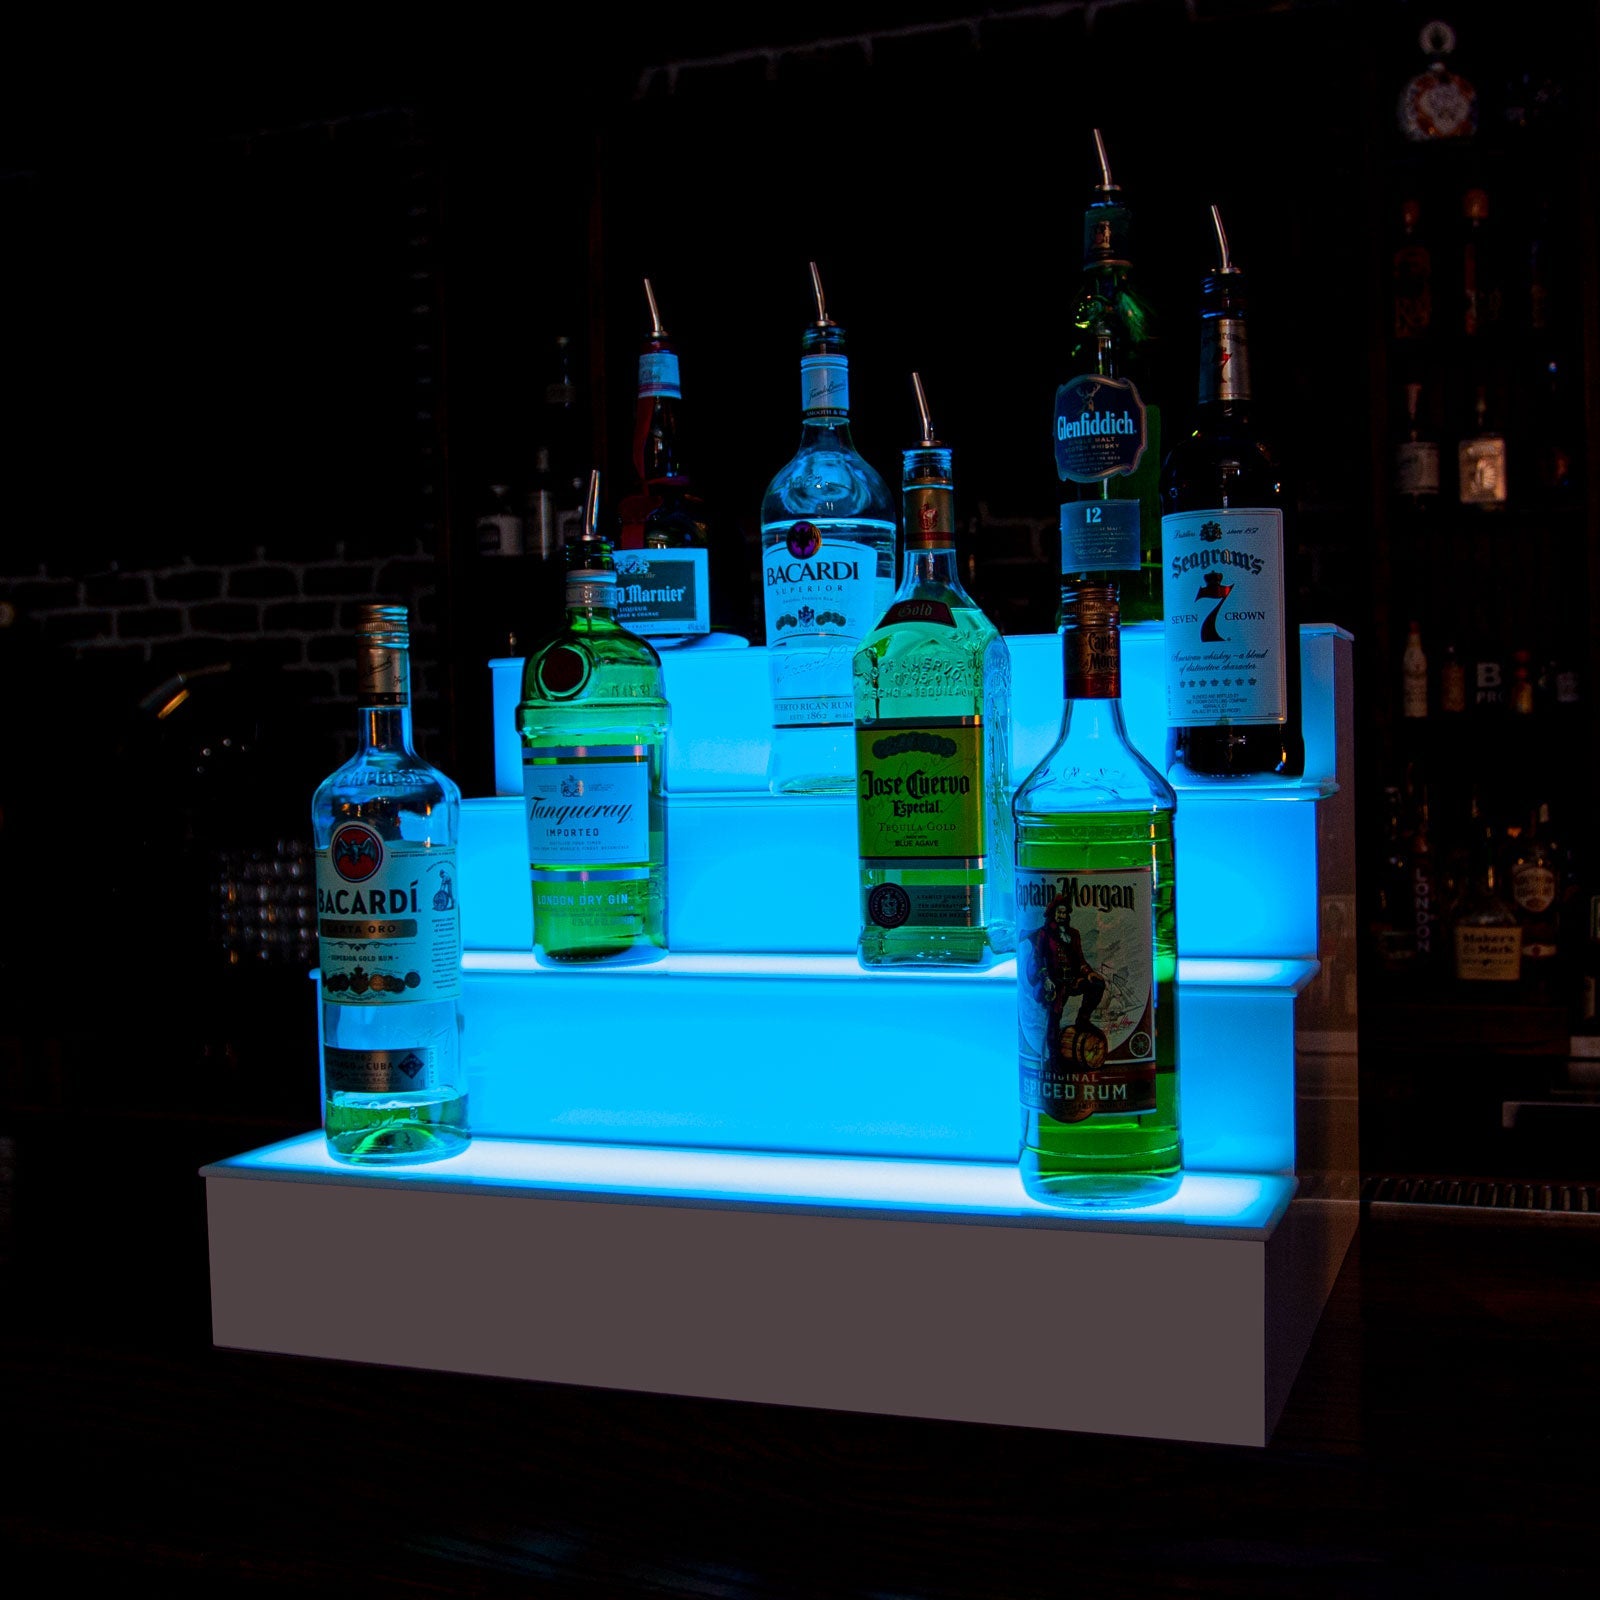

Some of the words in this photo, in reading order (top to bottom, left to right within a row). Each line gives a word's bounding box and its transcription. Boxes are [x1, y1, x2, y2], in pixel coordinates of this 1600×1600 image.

[1057, 411, 1134, 441] Glenfiddich
[1086, 507, 1102, 523] 12
[1172, 549, 1265, 579] Seagram's
[767, 562, 859, 586] BACARDI
[626, 585, 685, 603] Marnier
[776, 585, 843, 595] SUPERIOR
[898, 603, 933, 617] Gold
[1171, 614, 1198, 624] SEVEN
[1224, 612, 1265, 621] CROWN
[1194, 585, 1234, 642] 7
[800, 702, 829, 711] RICAN
[831, 701, 853, 709] RUM
[861, 770, 903, 800] Jose
[906, 769, 970, 800] Cuervo
[530, 796, 633, 825] Tanqueray
[546, 828, 599, 837] IMPORTED
[927, 821, 957, 832] GOLD
[915, 839, 939, 847] AGAVE
[318, 879, 418, 915] BACARDÍ
[537, 895, 574, 906] LONDON
[579, 895, 602, 905] DRY
[608, 894, 628, 904] GIN
[1057, 877, 1135, 913] Morgan
[368, 925, 396, 934] ORO
[366, 1062, 393, 1071] CUBA
[1023, 1077, 1076, 1100] SPICED
[1084, 1083, 1127, 1100] RUM
